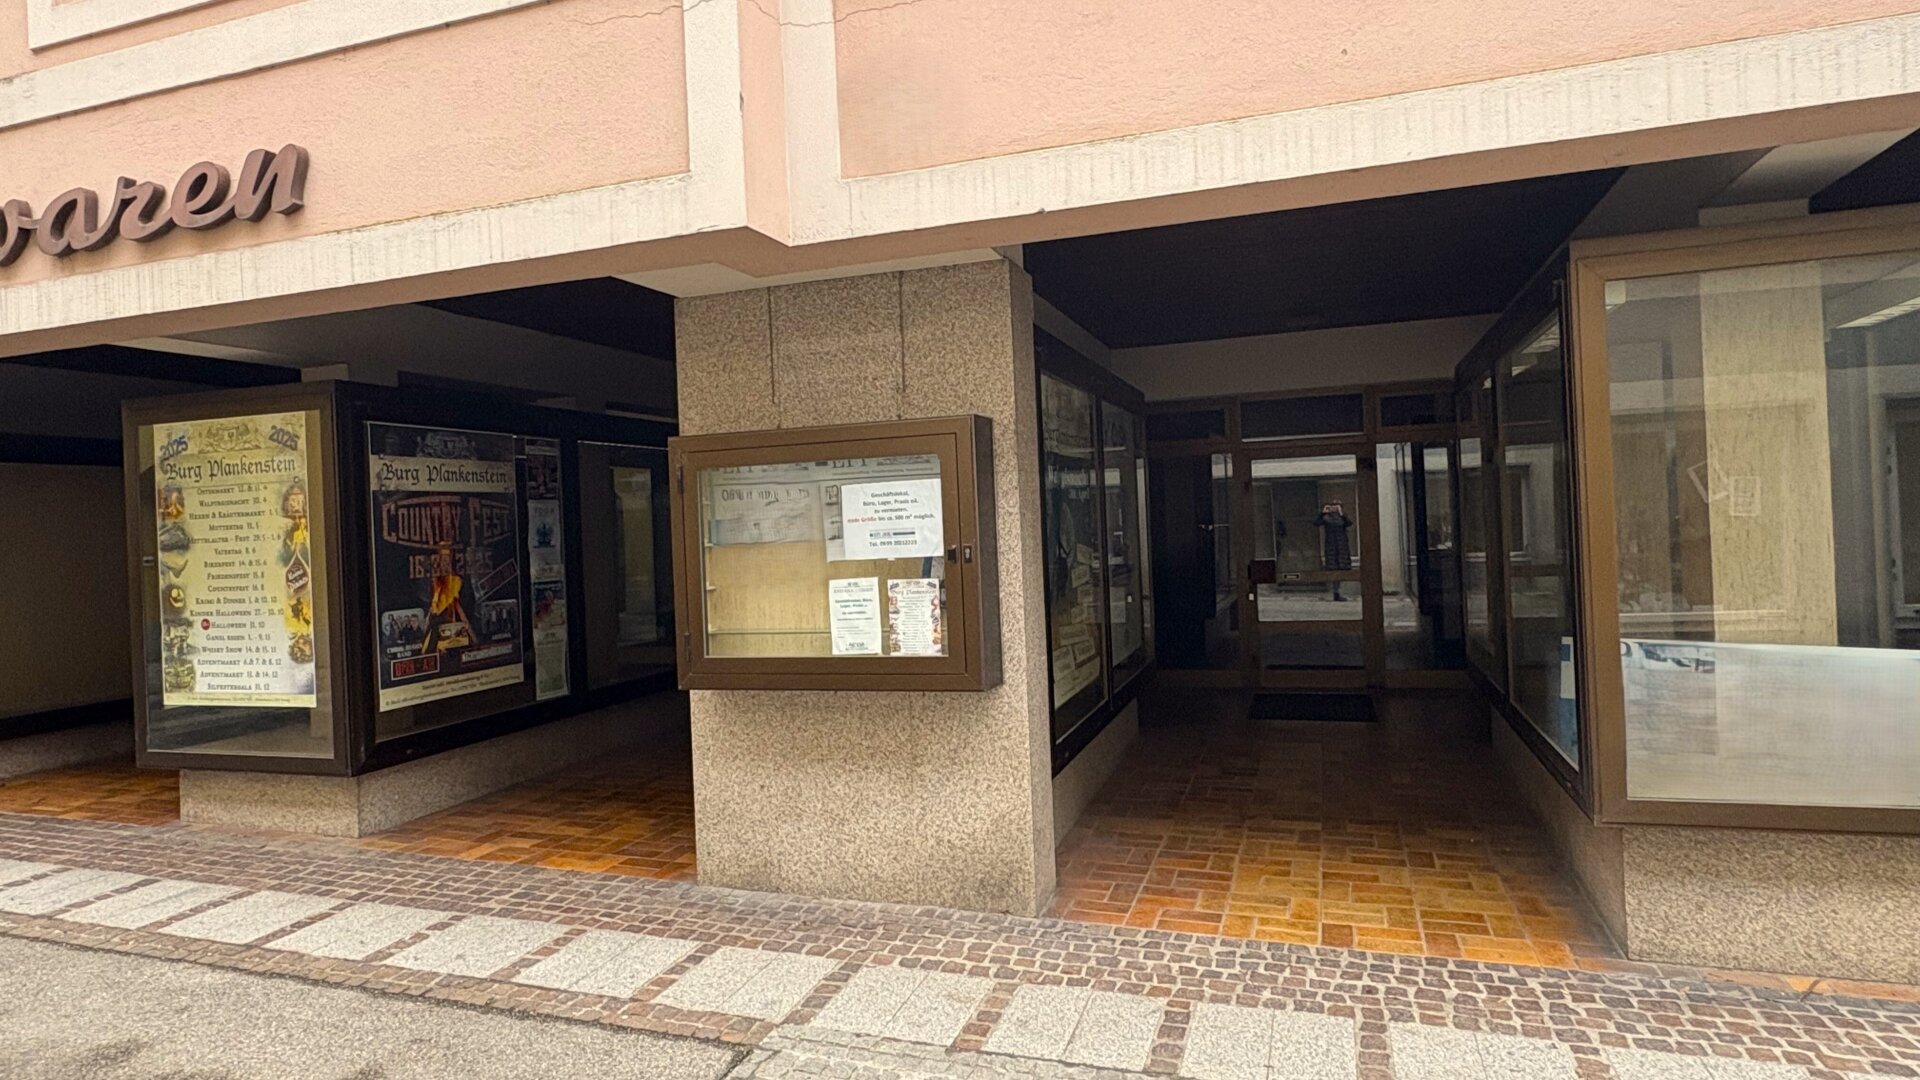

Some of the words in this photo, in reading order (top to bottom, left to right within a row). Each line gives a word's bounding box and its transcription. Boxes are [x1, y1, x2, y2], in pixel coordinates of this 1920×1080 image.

[160, 436, 188, 462] 2025
[268, 425, 300, 450] 2025
[166, 462, 202, 482] Burg
[208, 455, 296, 481] Plankenstein
[383, 464, 420, 485] Burg
[426, 464, 507, 485] Plankenstein
